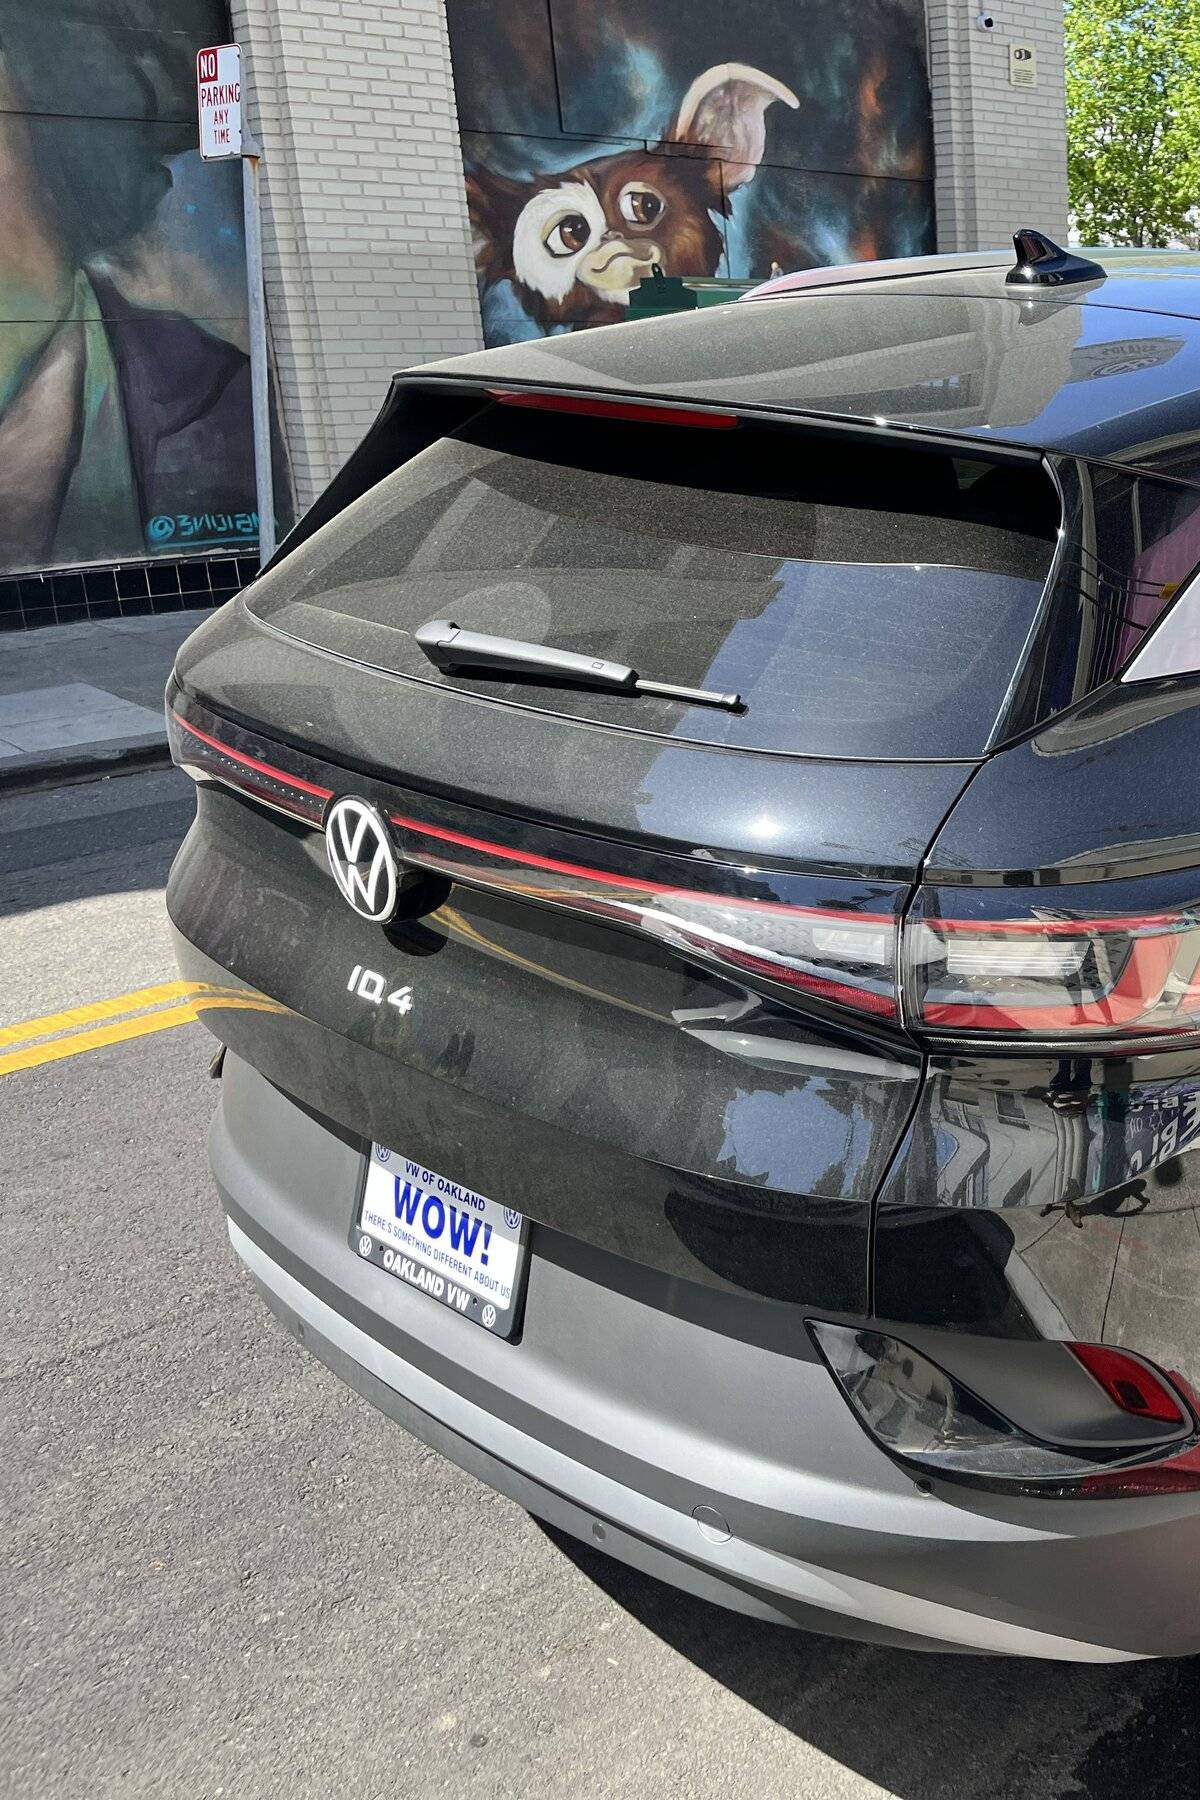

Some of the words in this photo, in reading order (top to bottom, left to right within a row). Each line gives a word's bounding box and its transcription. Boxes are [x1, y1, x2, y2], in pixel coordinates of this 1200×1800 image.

[200, 54, 216, 78] NO
[201, 83, 240, 107] PARKING
[213, 110, 229, 125] ANY
[214, 129, 230, 144] TIME
[405, 1161, 420, 1178] VW
[422, 1171, 436, 1184] OF
[437, 1178, 486, 1211] OAKLAND
[394, 1175, 493, 1266] WOW!
[364, 1211, 392, 1234] THERE'S
[393, 1225, 432, 1257] SOMETHING
[433, 1249, 473, 1278] DIFFERENT
[474, 1271, 499, 1293] ABOUT
[500, 1283, 511, 1299] US
[383, 1249, 445, 1297] OAKLAND
[447, 1283, 471, 1311] VW
